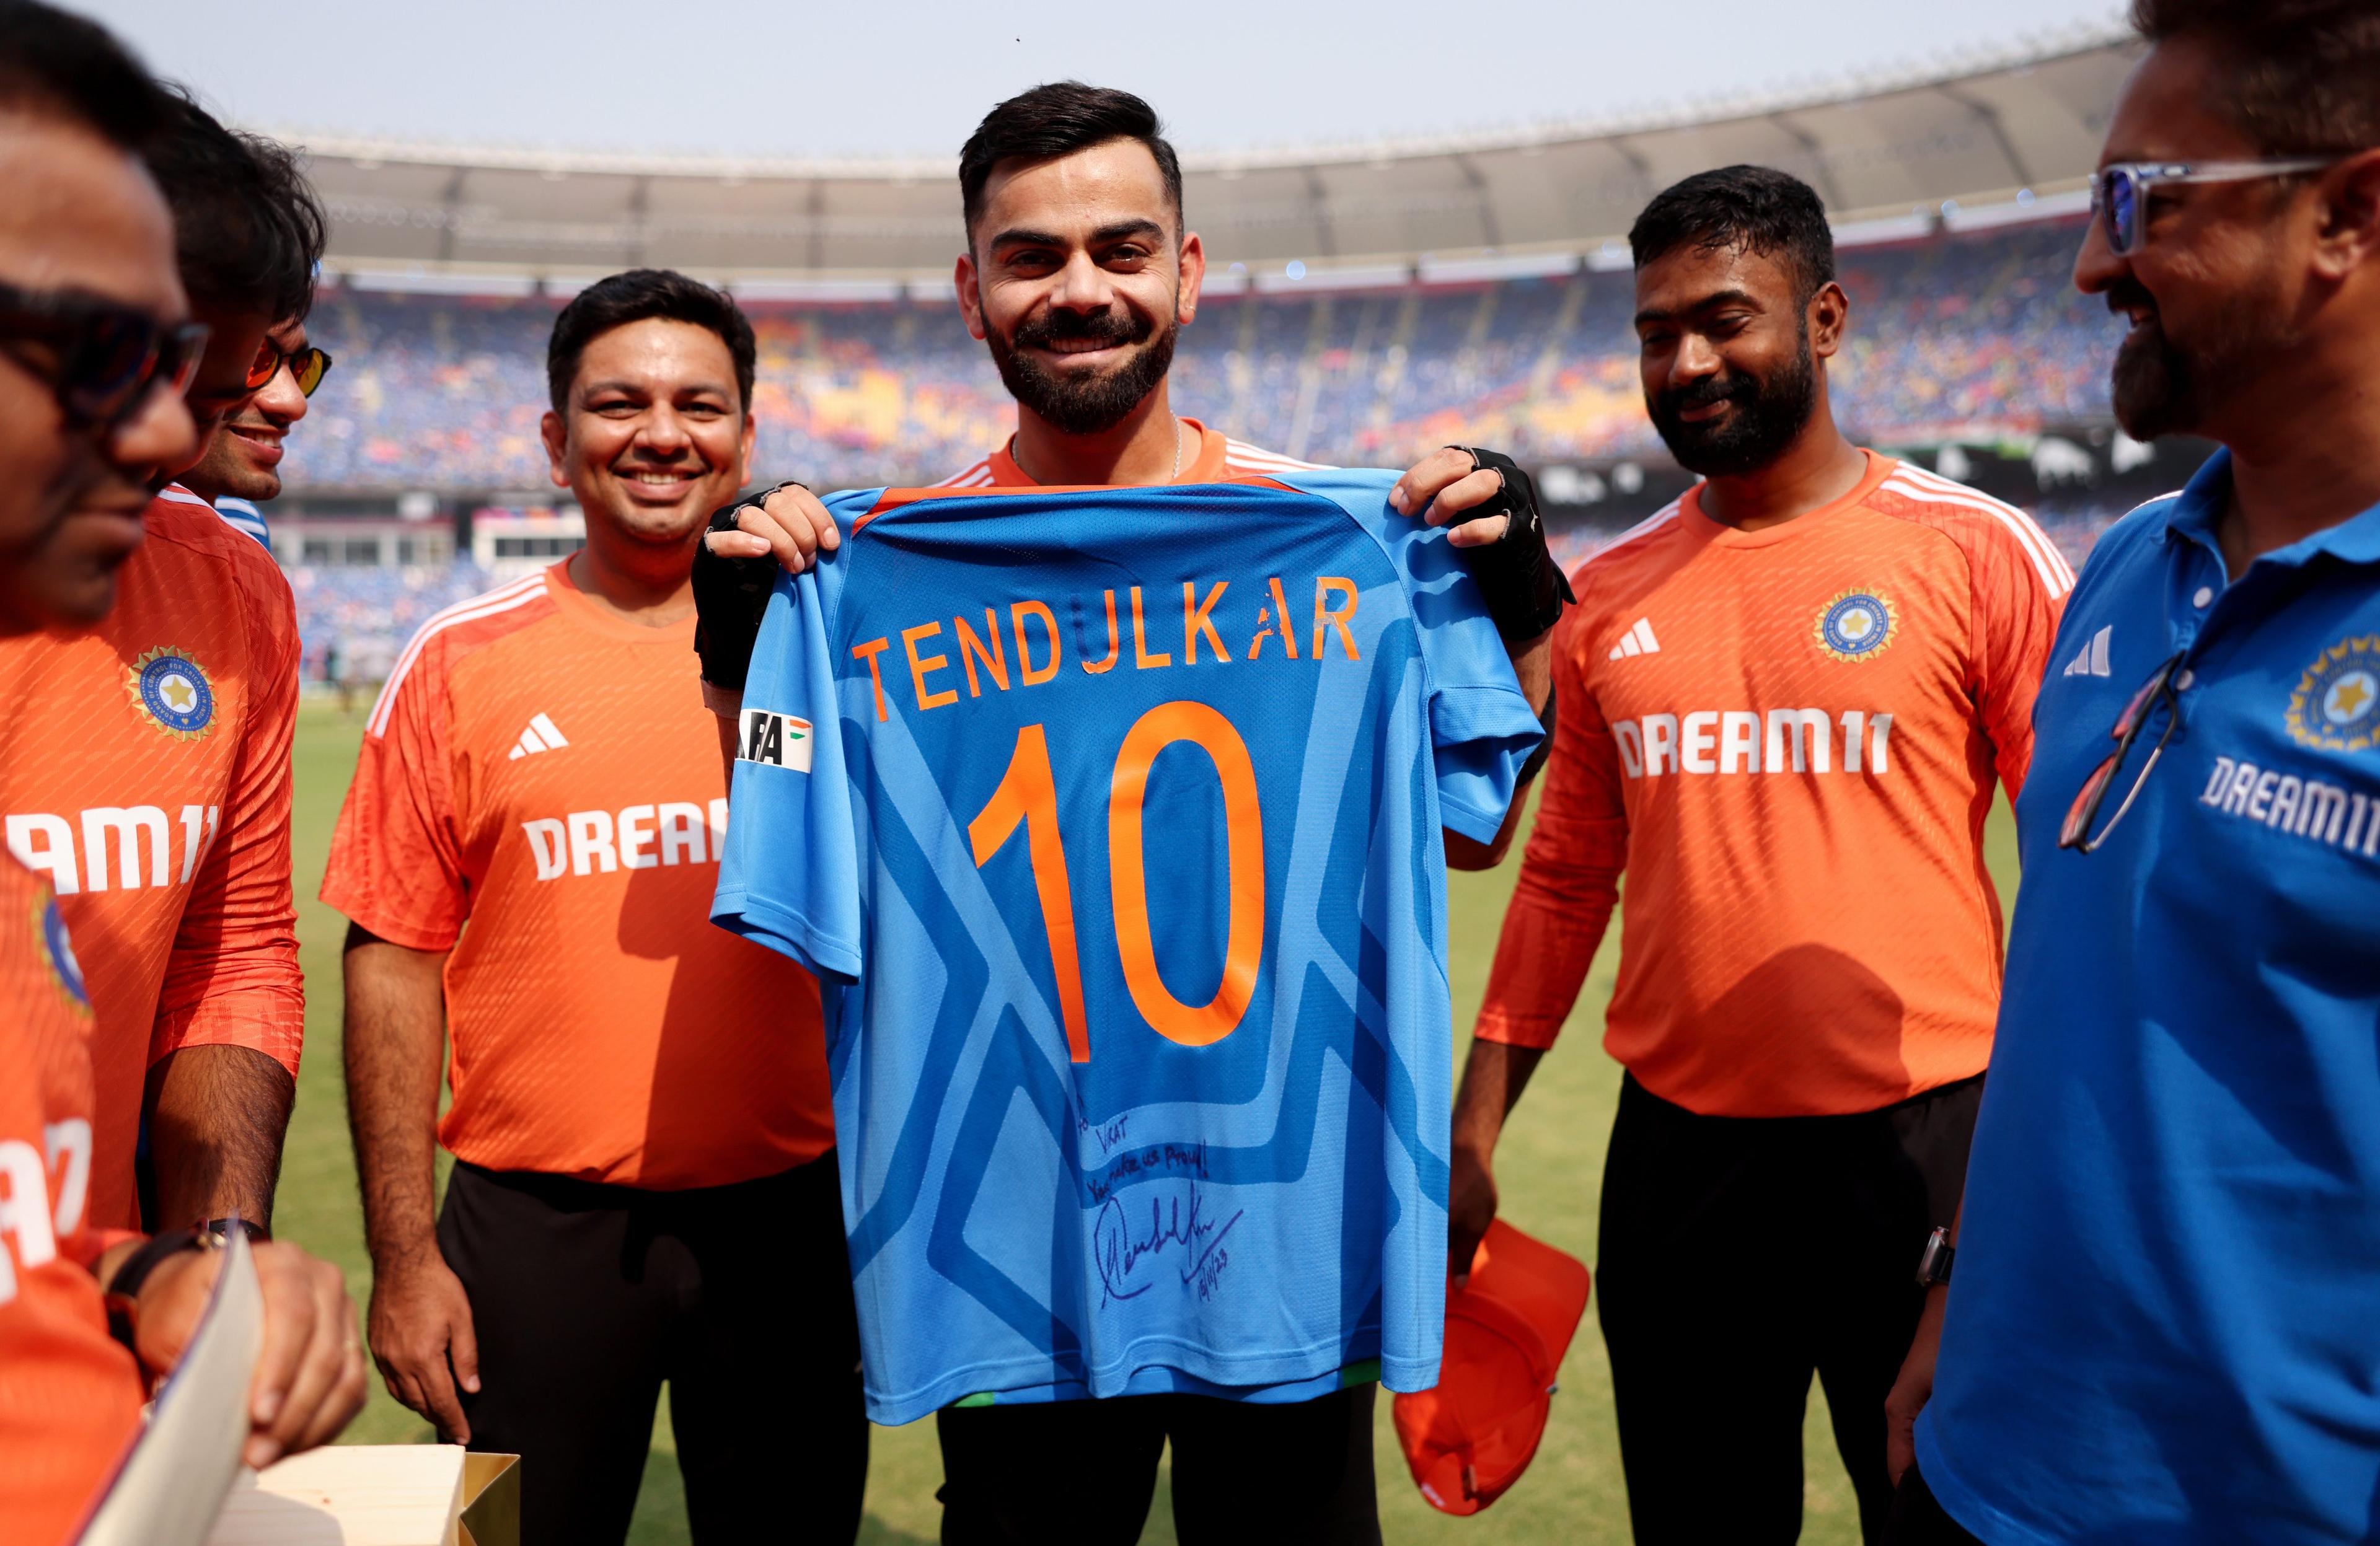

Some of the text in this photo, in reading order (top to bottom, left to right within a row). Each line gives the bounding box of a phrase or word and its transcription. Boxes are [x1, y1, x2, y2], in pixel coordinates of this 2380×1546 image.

[852, 577, 1360, 722] TENDULKAR
[1612, 708, 1893, 779] DREAM11
[967, 700, 1265, 1063] 10
